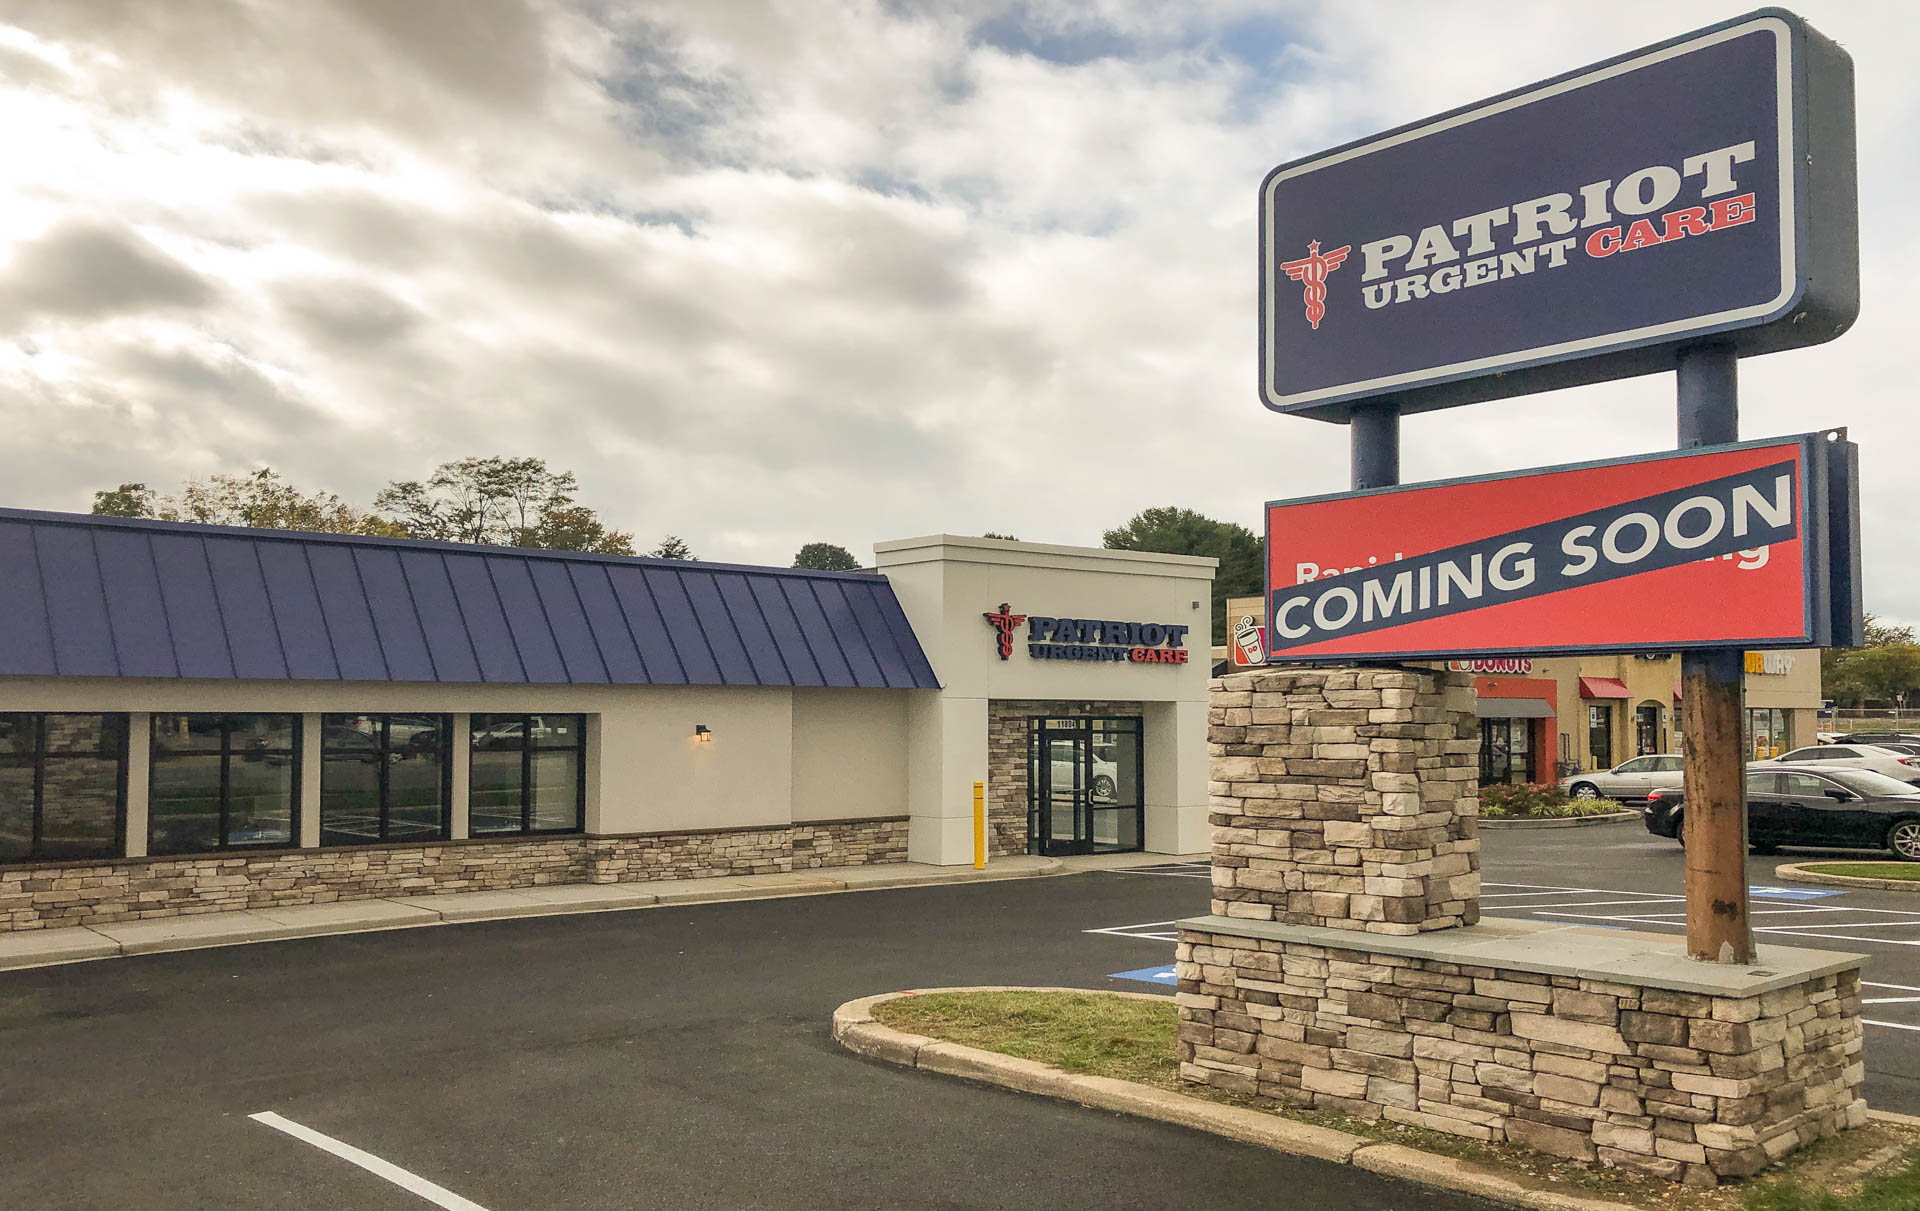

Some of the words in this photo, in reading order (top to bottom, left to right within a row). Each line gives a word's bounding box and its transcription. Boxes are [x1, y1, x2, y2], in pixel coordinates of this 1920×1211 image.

[1361, 140, 1755, 282] PATRIOT
[1362, 237, 1577, 309] URGENT
[1585, 193, 1756, 258] CARE
[1275, 542, 1538, 640] COMING
[1560, 474, 1792, 577] SOON
[1028, 616, 1188, 647] PATRIOT
[1028, 643, 1128, 661] URGENT
[1130, 648, 1189, 664] CARE
[1473, 658, 1532, 673] DONUTS
[1745, 652, 1792, 675] UBWAY
